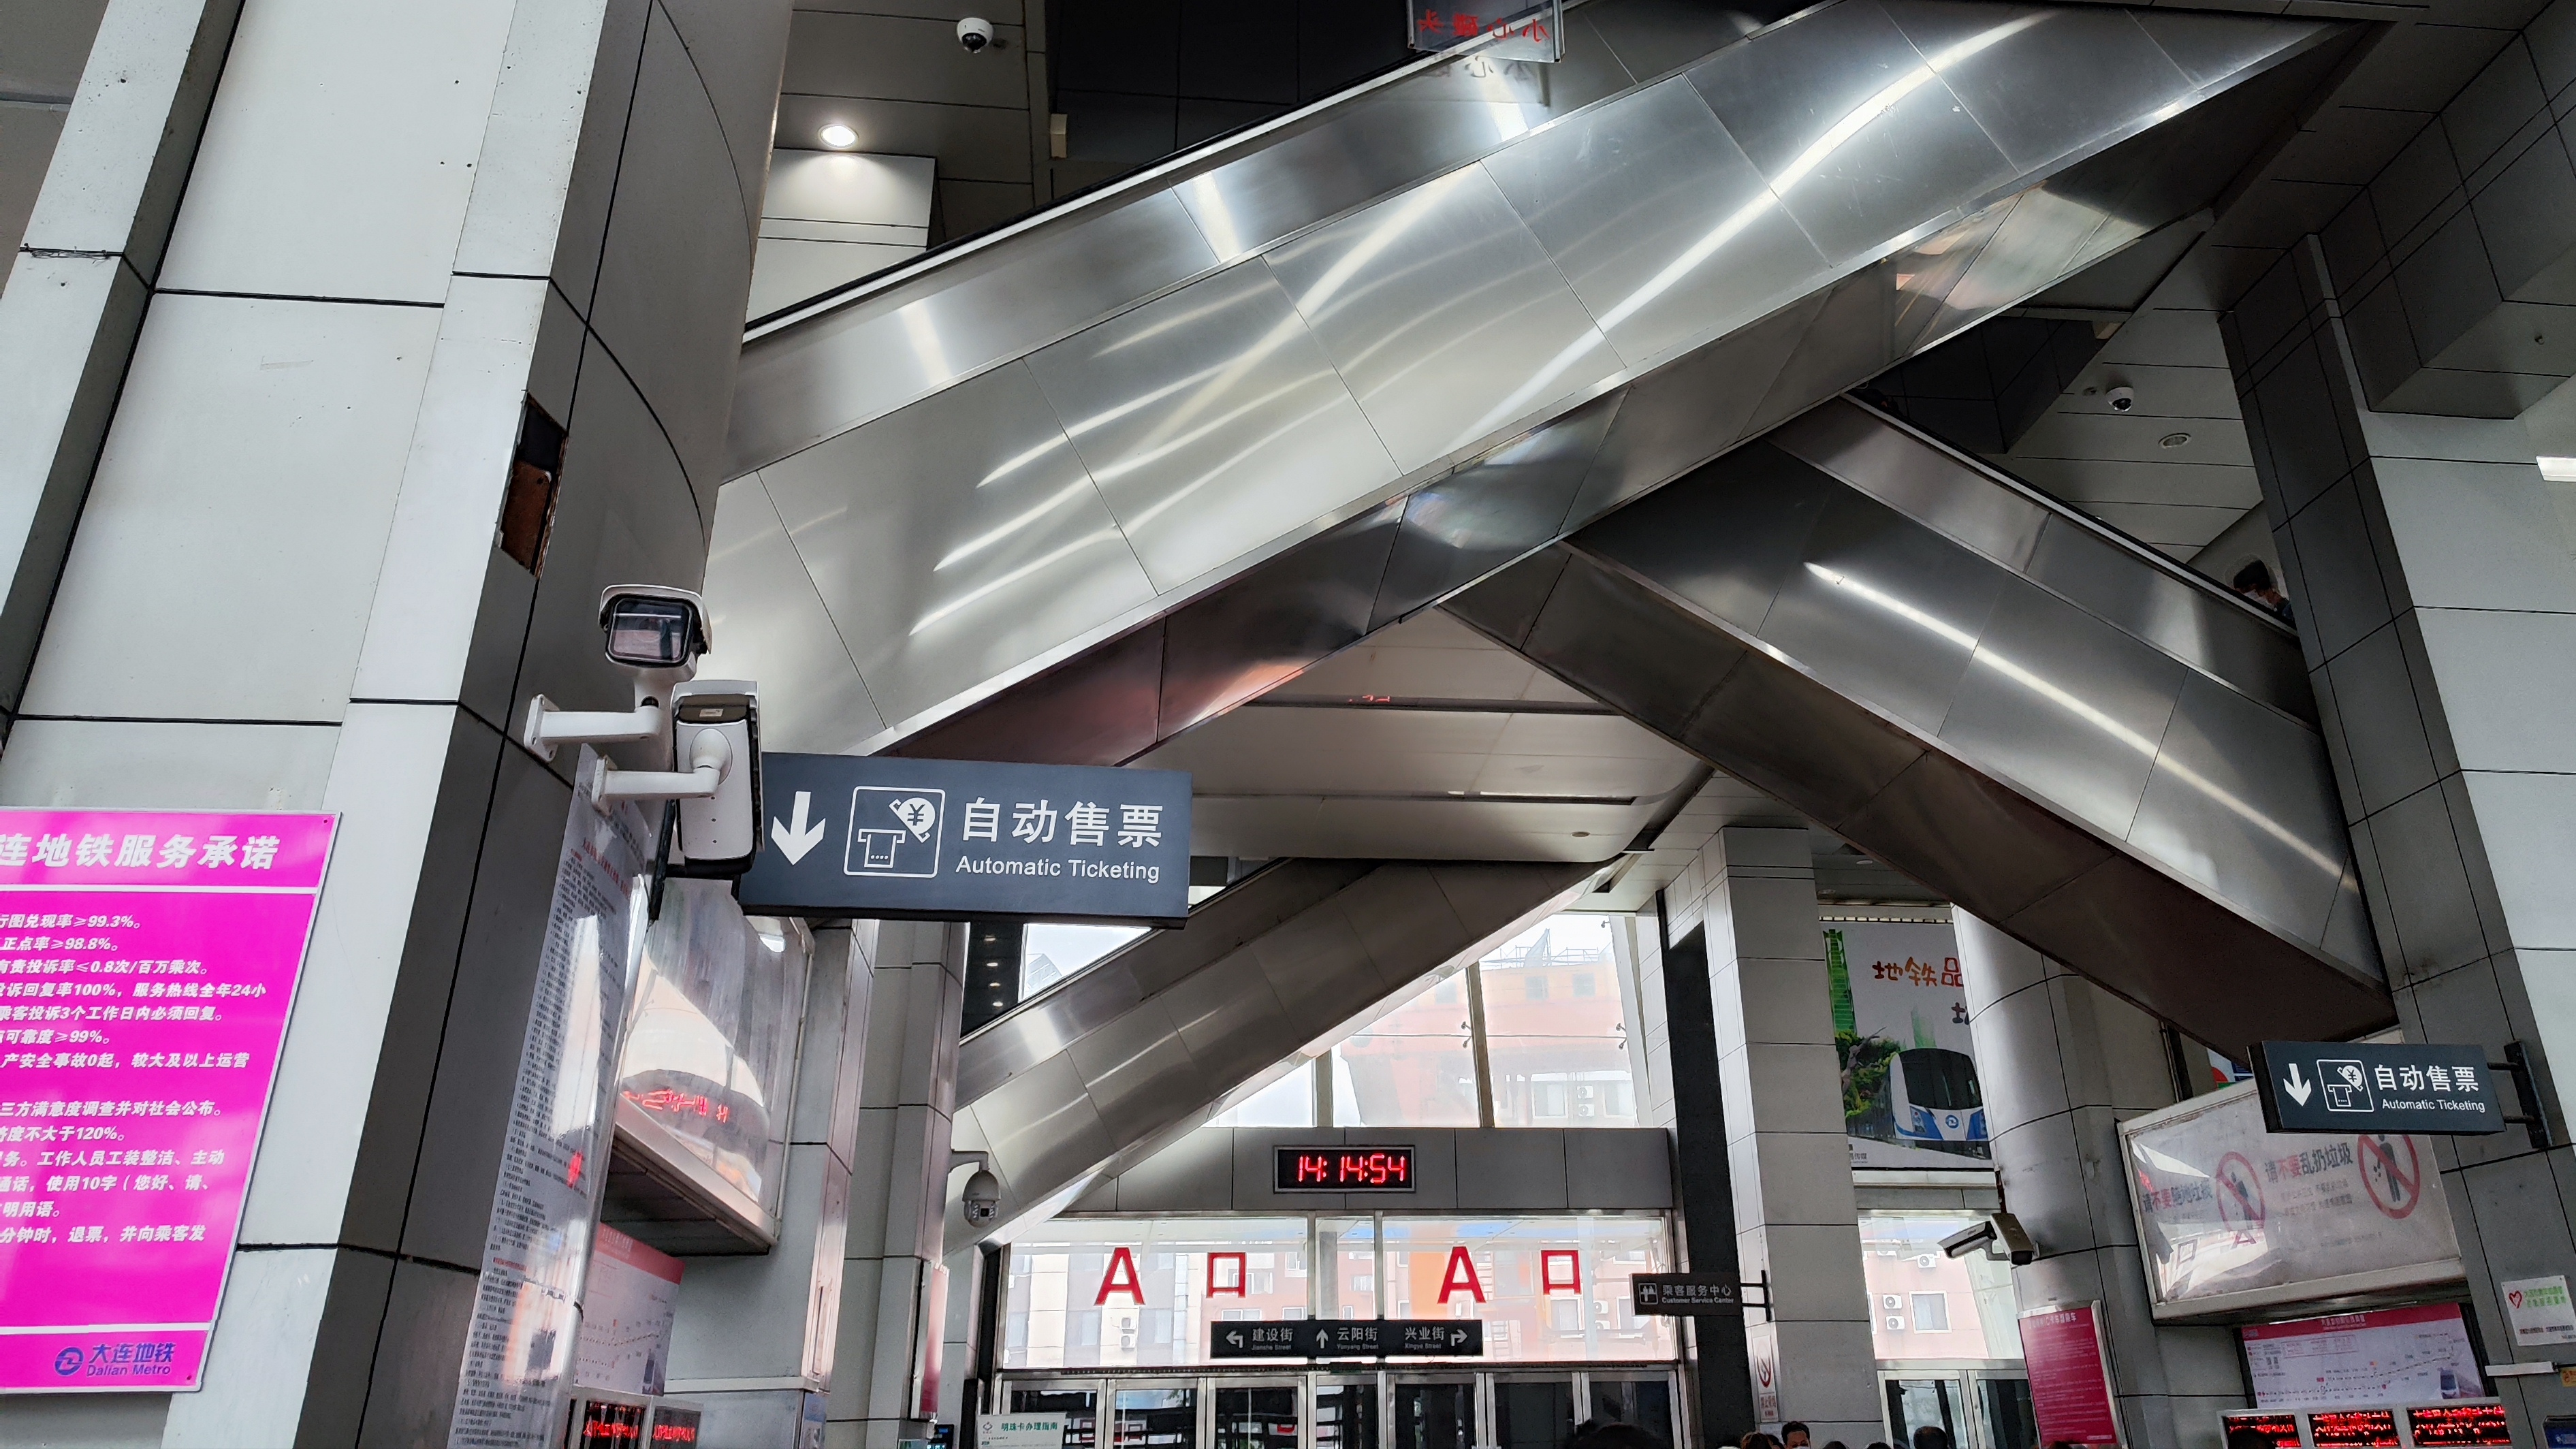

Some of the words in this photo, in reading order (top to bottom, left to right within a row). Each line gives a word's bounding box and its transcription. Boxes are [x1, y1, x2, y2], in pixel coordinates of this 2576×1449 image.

[961, 797, 1163, 848] 自动售票
[0, 833, 280, 870] 连地铁服务承诺
[955, 855, 1061, 878] Automatic
[1067, 859, 1160, 885] Ticketing
[0, 936, 118, 951] 正点率≥98.8%。
[1871, 956, 1963, 987] 地铁品
[0, 1029, 110, 1045] 可靠度≥99%。
[0, 1052, 250, 1069] 产安全事故0起，较大及以上运营
[2374, 1063, 2479, 1093] 自动售票
[2382, 1098, 2435, 1111] Automatic
[2436, 1099, 2485, 1113] Ticketing
[0, 1150, 225, 1167] 务。工作人员工装整洁、主动
[2265, 1142, 2353, 1184] 请不要乱扔垃圾
[0, 1200, 60, 1217] 明用语。
[1094, 1247, 1145, 1307] A
[1206, 1251, 1246, 1299] 口
[1437, 1245, 1487, 1304] A
[1541, 1249, 1582, 1295] 口
[1662, 1284, 1732, 1296] 乘客服务中心
[1252, 1327, 1293, 1342] 建设街
[1337, 1327, 1378, 1342] 云阳街
[1405, 1326, 1445, 1341] 兴业街
[90, 1342, 176, 1364] 大连地铁
[86, 1364, 128, 1377] Dalian
[132, 1364, 171, 1375] Metro
[1001, 1422, 1058, 1431] 明珠卡办理指南
